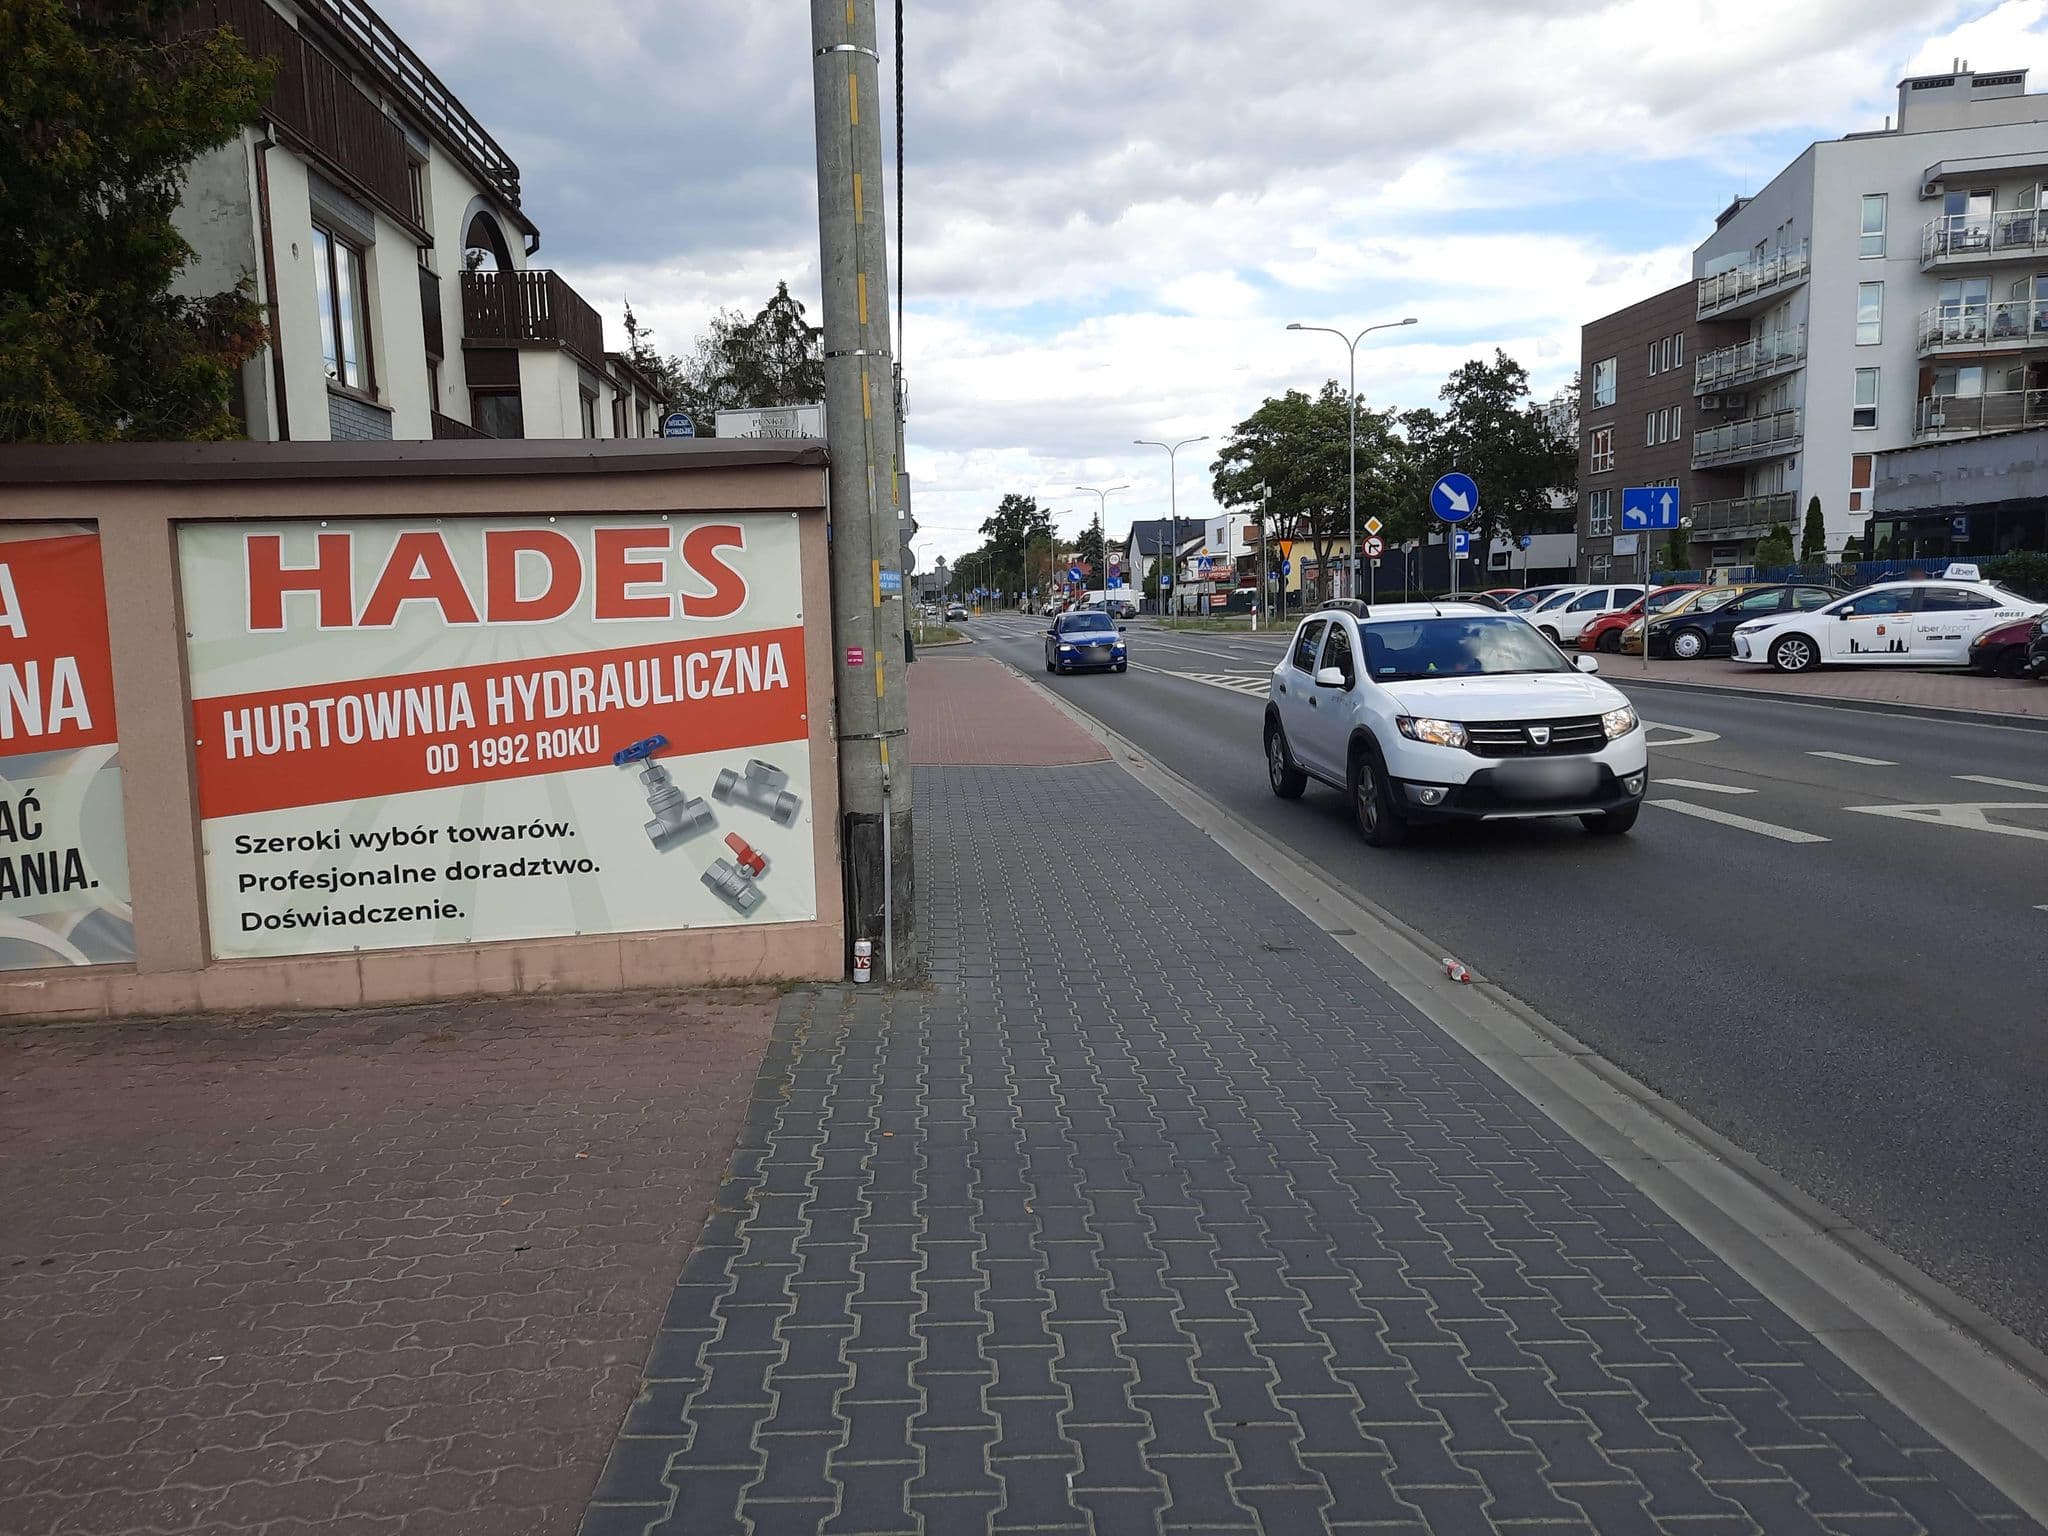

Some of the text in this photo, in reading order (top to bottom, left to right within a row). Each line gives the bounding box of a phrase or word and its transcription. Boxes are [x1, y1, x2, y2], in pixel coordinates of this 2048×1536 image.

[245, 523, 747, 633] HADES
[1950, 567, 1975, 576] Uber
[1917, 624, 1939, 632] Uber
[223, 642, 789, 759] HURTOWNIA HYDRAULICZNA
[426, 724, 600, 775] OD 1992 ROKU
[235, 819, 575, 854] Szeroki wybór towarów.
[238, 857, 600, 893] Profesjonalne doradztwo.
[241, 899, 465, 931] Doświadczenie.
